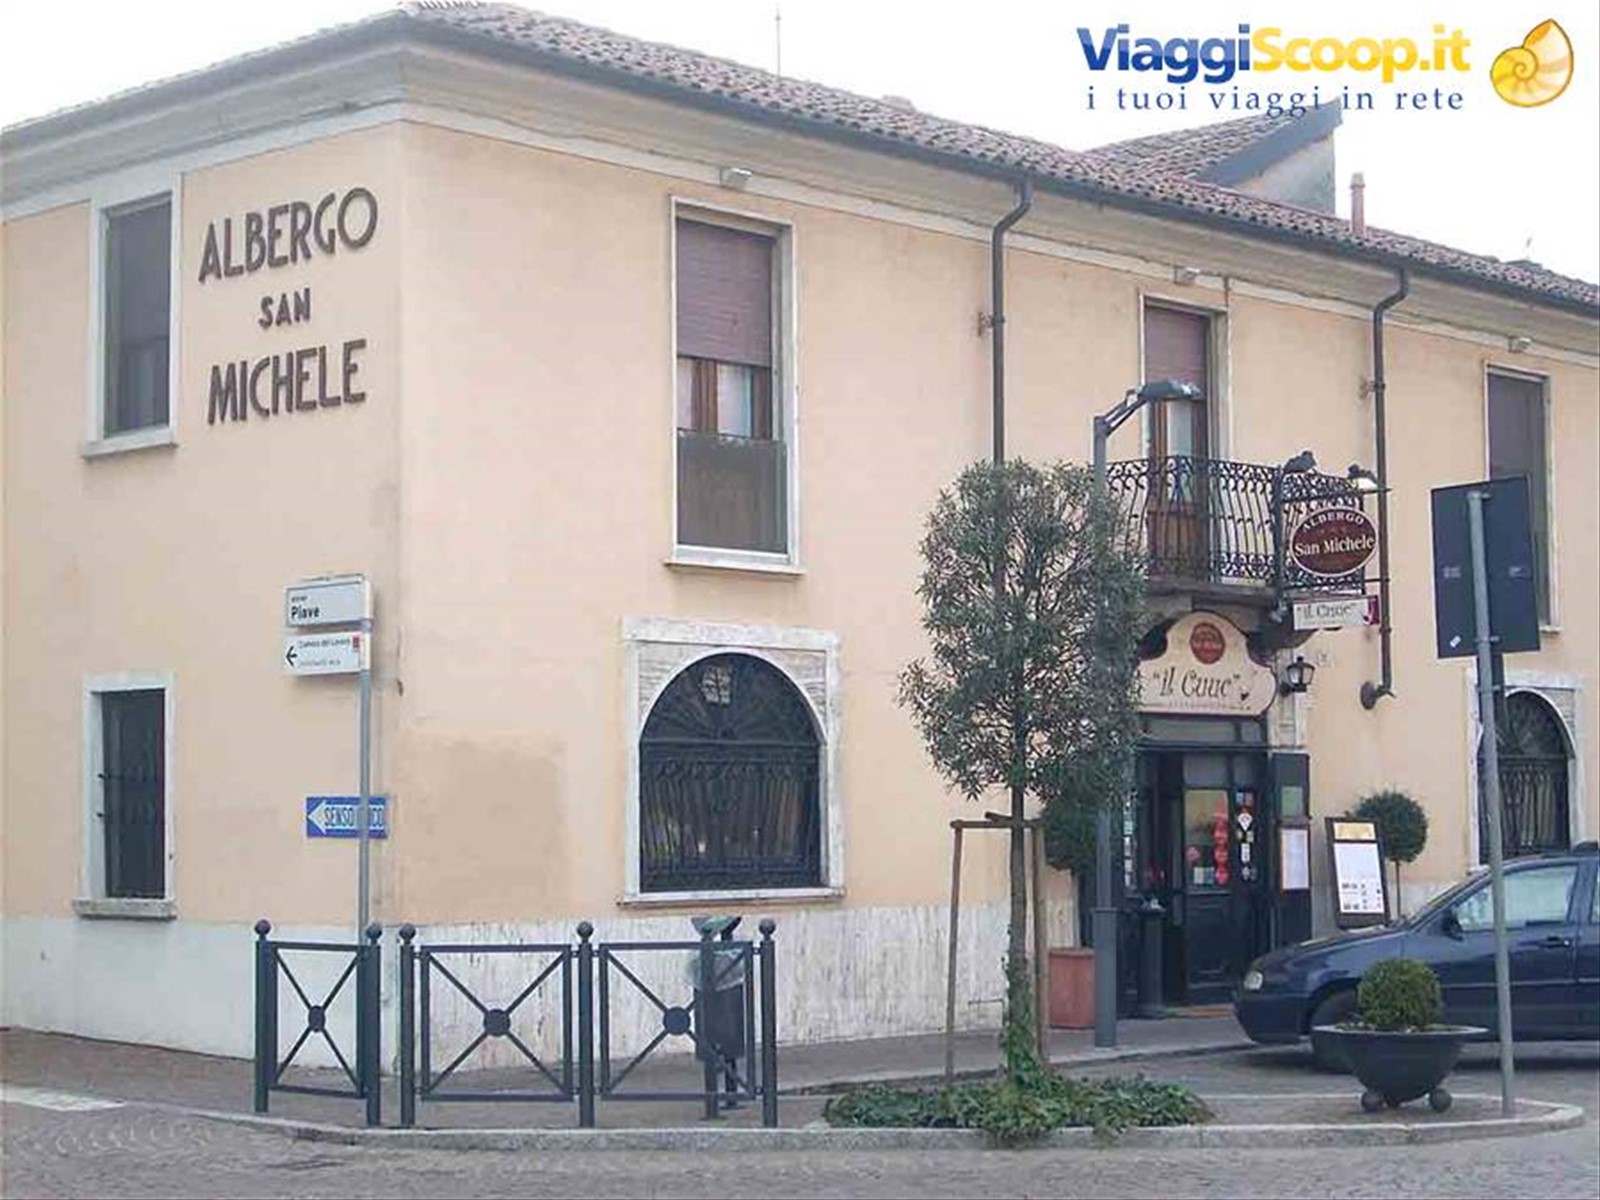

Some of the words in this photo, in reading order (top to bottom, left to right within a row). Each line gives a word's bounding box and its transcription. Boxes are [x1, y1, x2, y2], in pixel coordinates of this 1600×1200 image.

[198, 187, 379, 284] ALBERGO
[258, 287, 311, 330] SAN
[207, 338, 367, 426] MICHELE
[1302, 511, 1365, 532] ALBERGO
[1295, 542, 1320, 557] San
[1323, 534, 1376, 554] Michele
[291, 604, 320, 619] Piave
